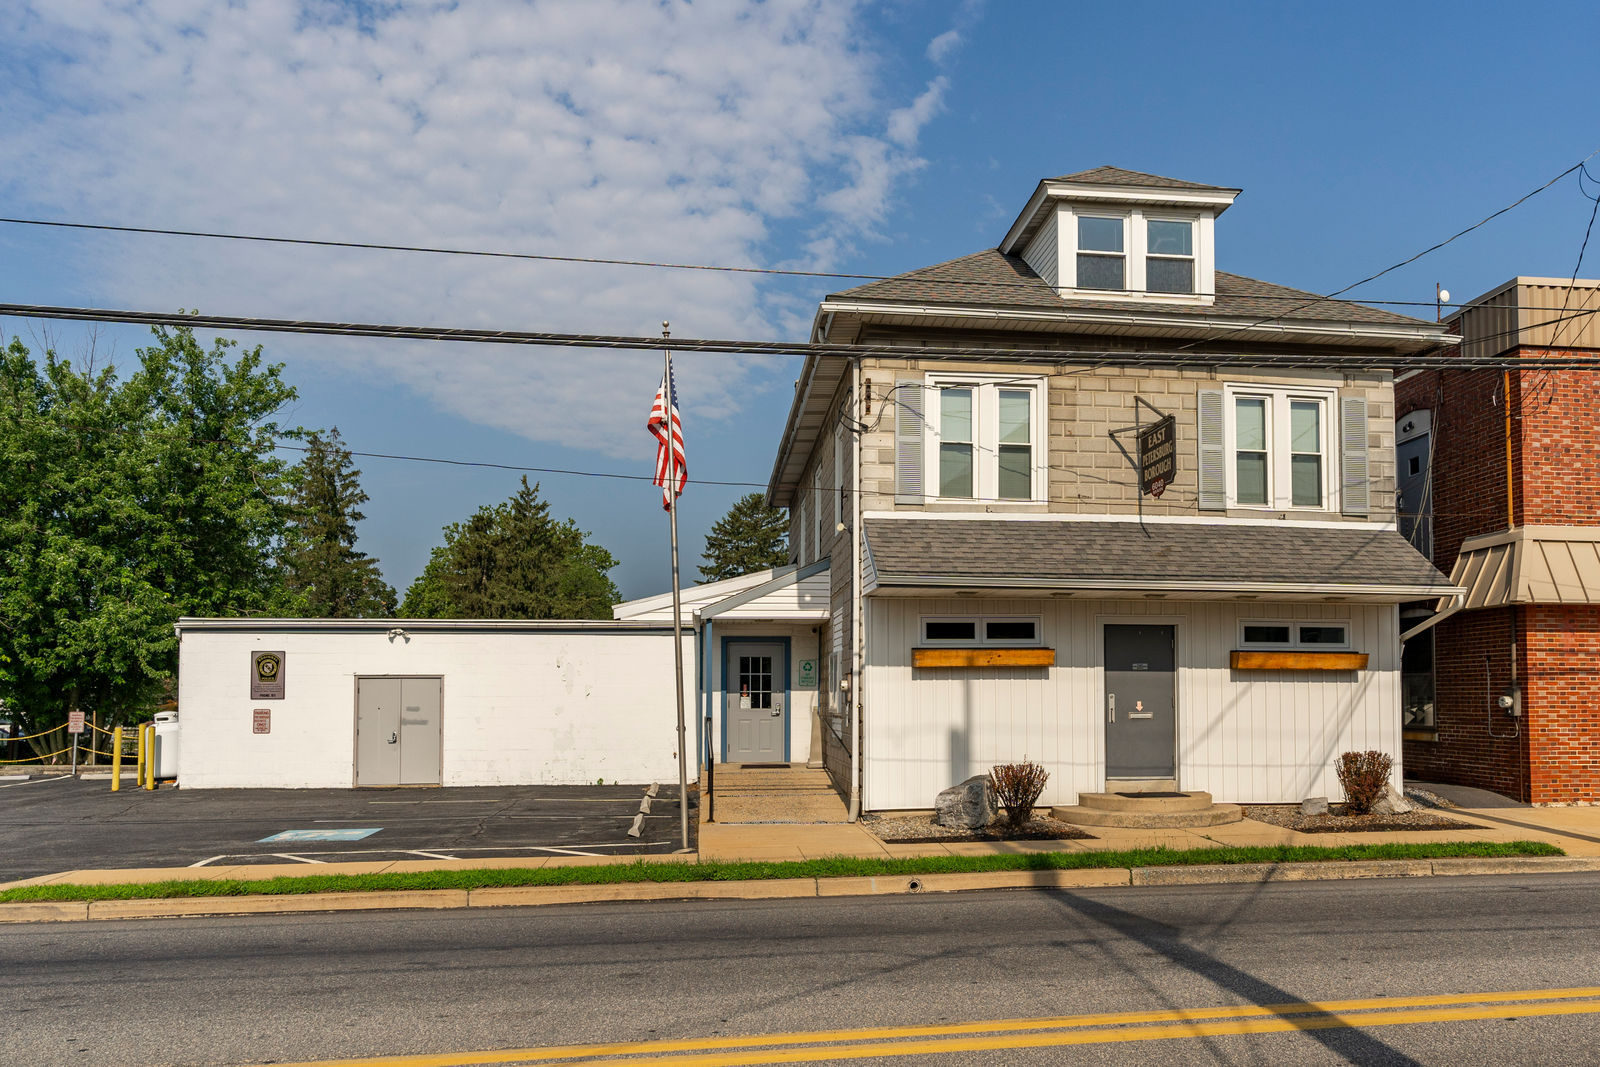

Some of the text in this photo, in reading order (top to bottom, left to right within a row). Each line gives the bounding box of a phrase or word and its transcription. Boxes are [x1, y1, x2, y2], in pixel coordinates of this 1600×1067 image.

[1148, 428, 1166, 448] EAST
[1142, 440, 1173, 467] PETERSBURG
[1144, 457, 1172, 482] BOROUGH
